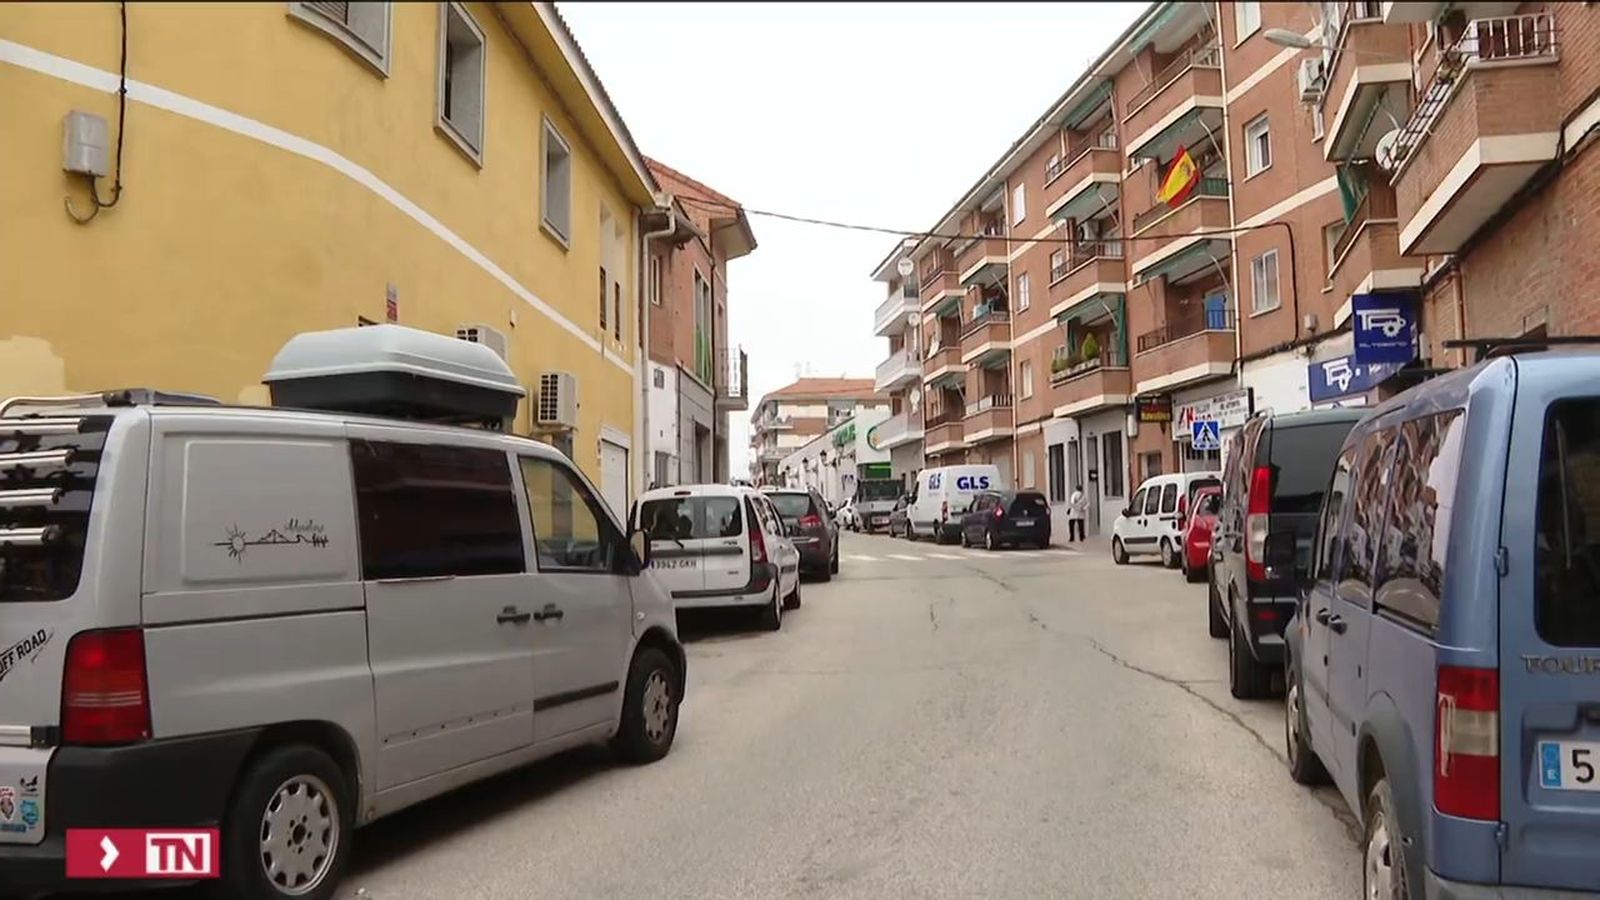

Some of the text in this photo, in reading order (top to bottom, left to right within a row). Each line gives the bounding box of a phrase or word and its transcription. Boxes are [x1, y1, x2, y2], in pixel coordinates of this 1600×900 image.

[929, 473, 942, 490] GLS
[957, 476, 989, 490] GLS
[16, 629, 47, 660] ROAD
[1572, 749, 1594, 783] 5
